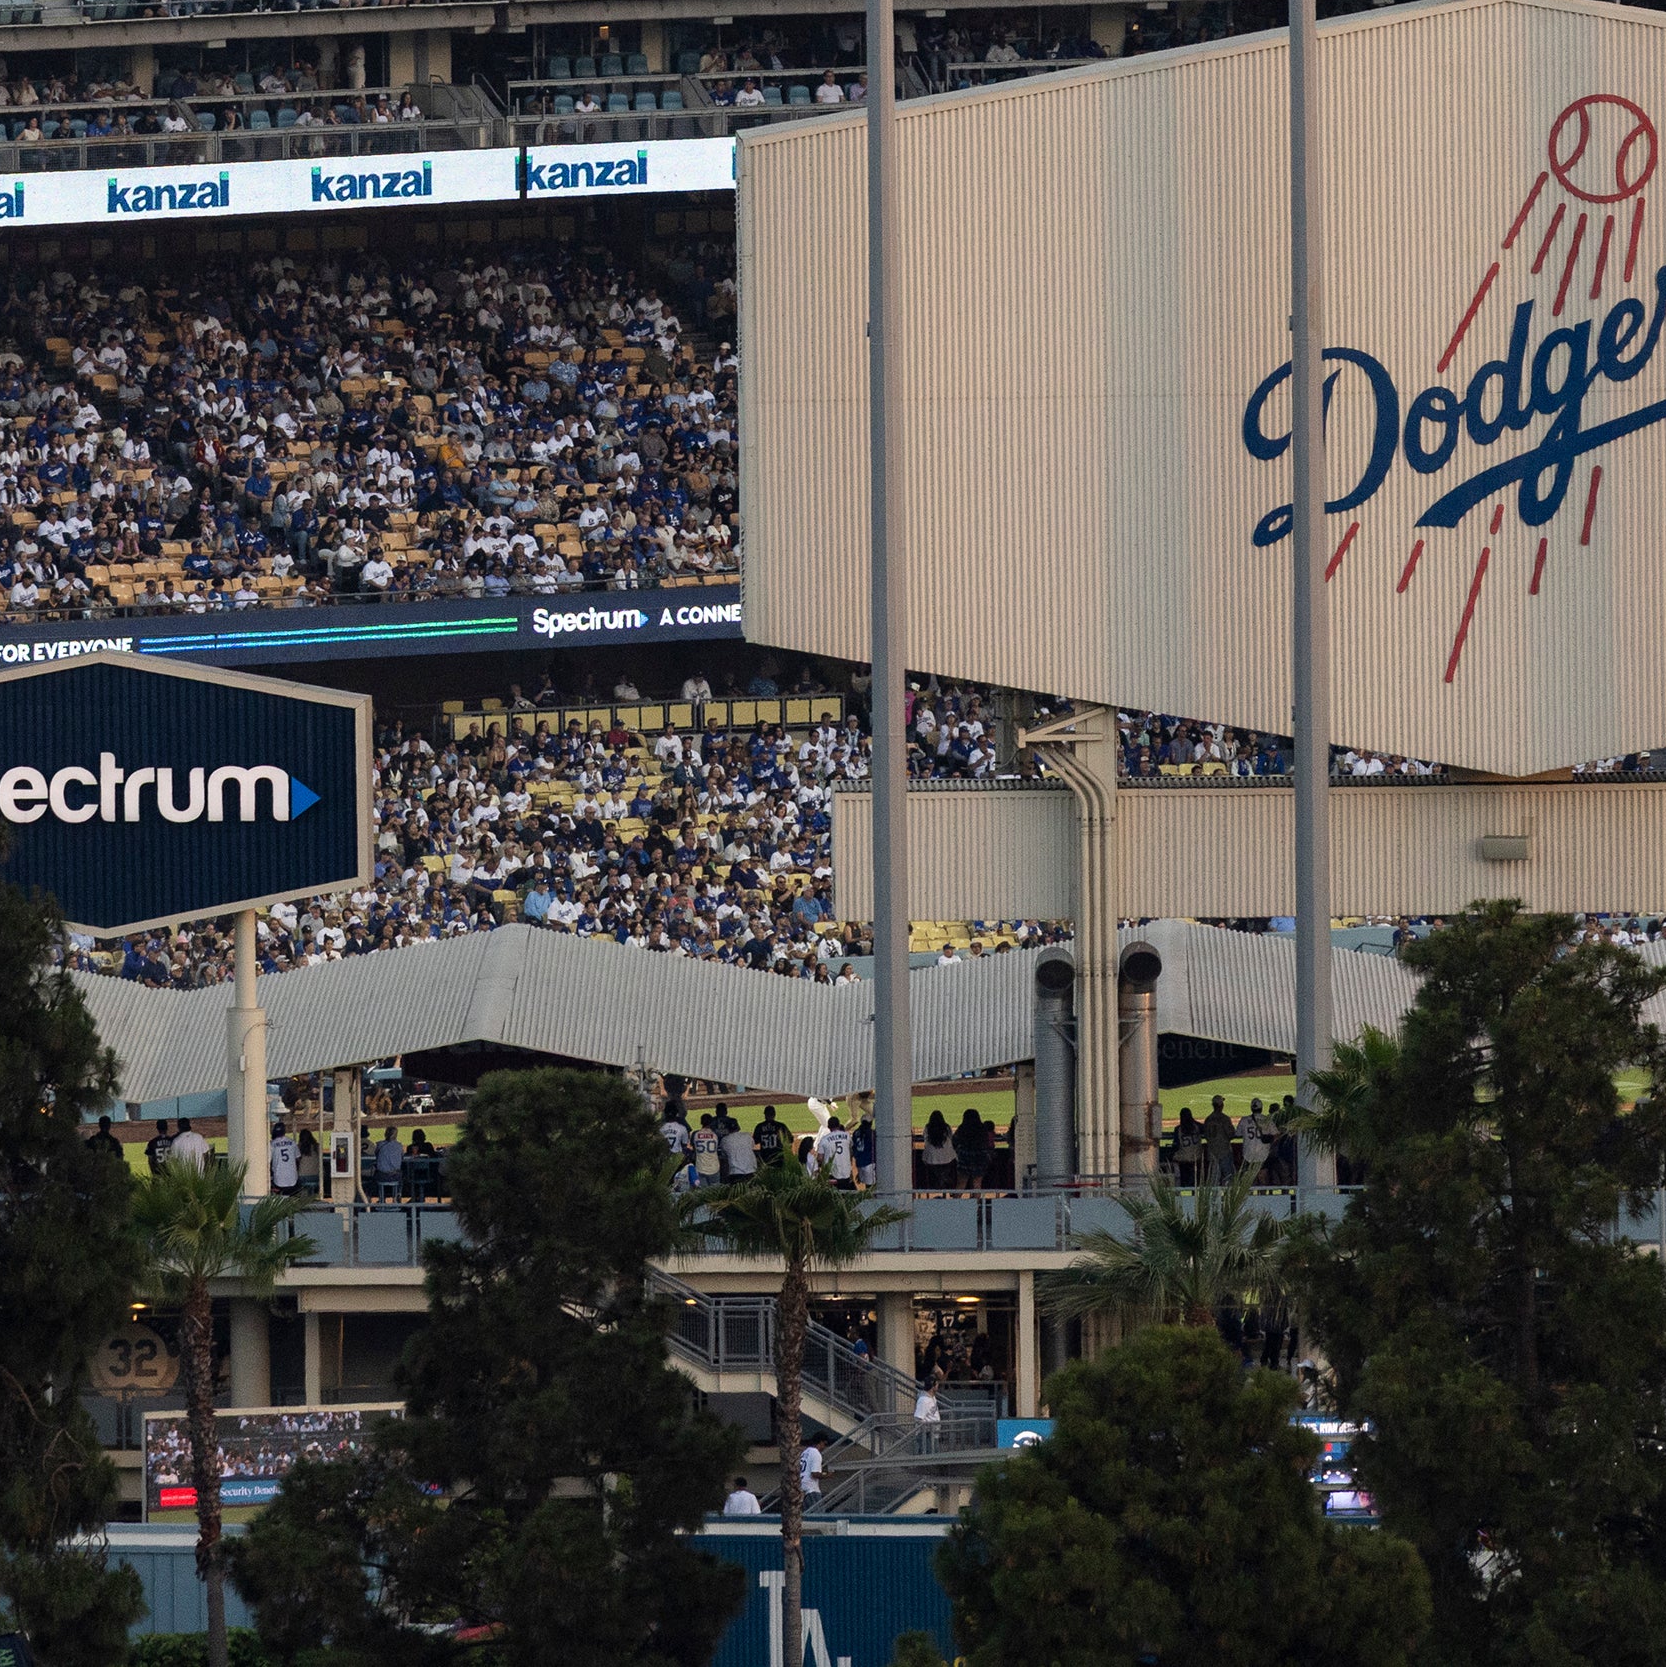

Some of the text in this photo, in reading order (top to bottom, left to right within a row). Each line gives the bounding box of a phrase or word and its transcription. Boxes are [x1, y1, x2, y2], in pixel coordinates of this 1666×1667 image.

[533, 607, 641, 639] Spectrum
[659, 607, 675, 626] A
[33, 637, 134, 662] EVERYONE
[695, 1140, 717, 1154] 50
[760, 1135, 778, 1149] 50
[834, 1141, 844, 1155] 5
[280, 1148, 290, 1163] 5
[109, 1338, 158, 1378] 32
[220, 1485, 252, 1498] Security
